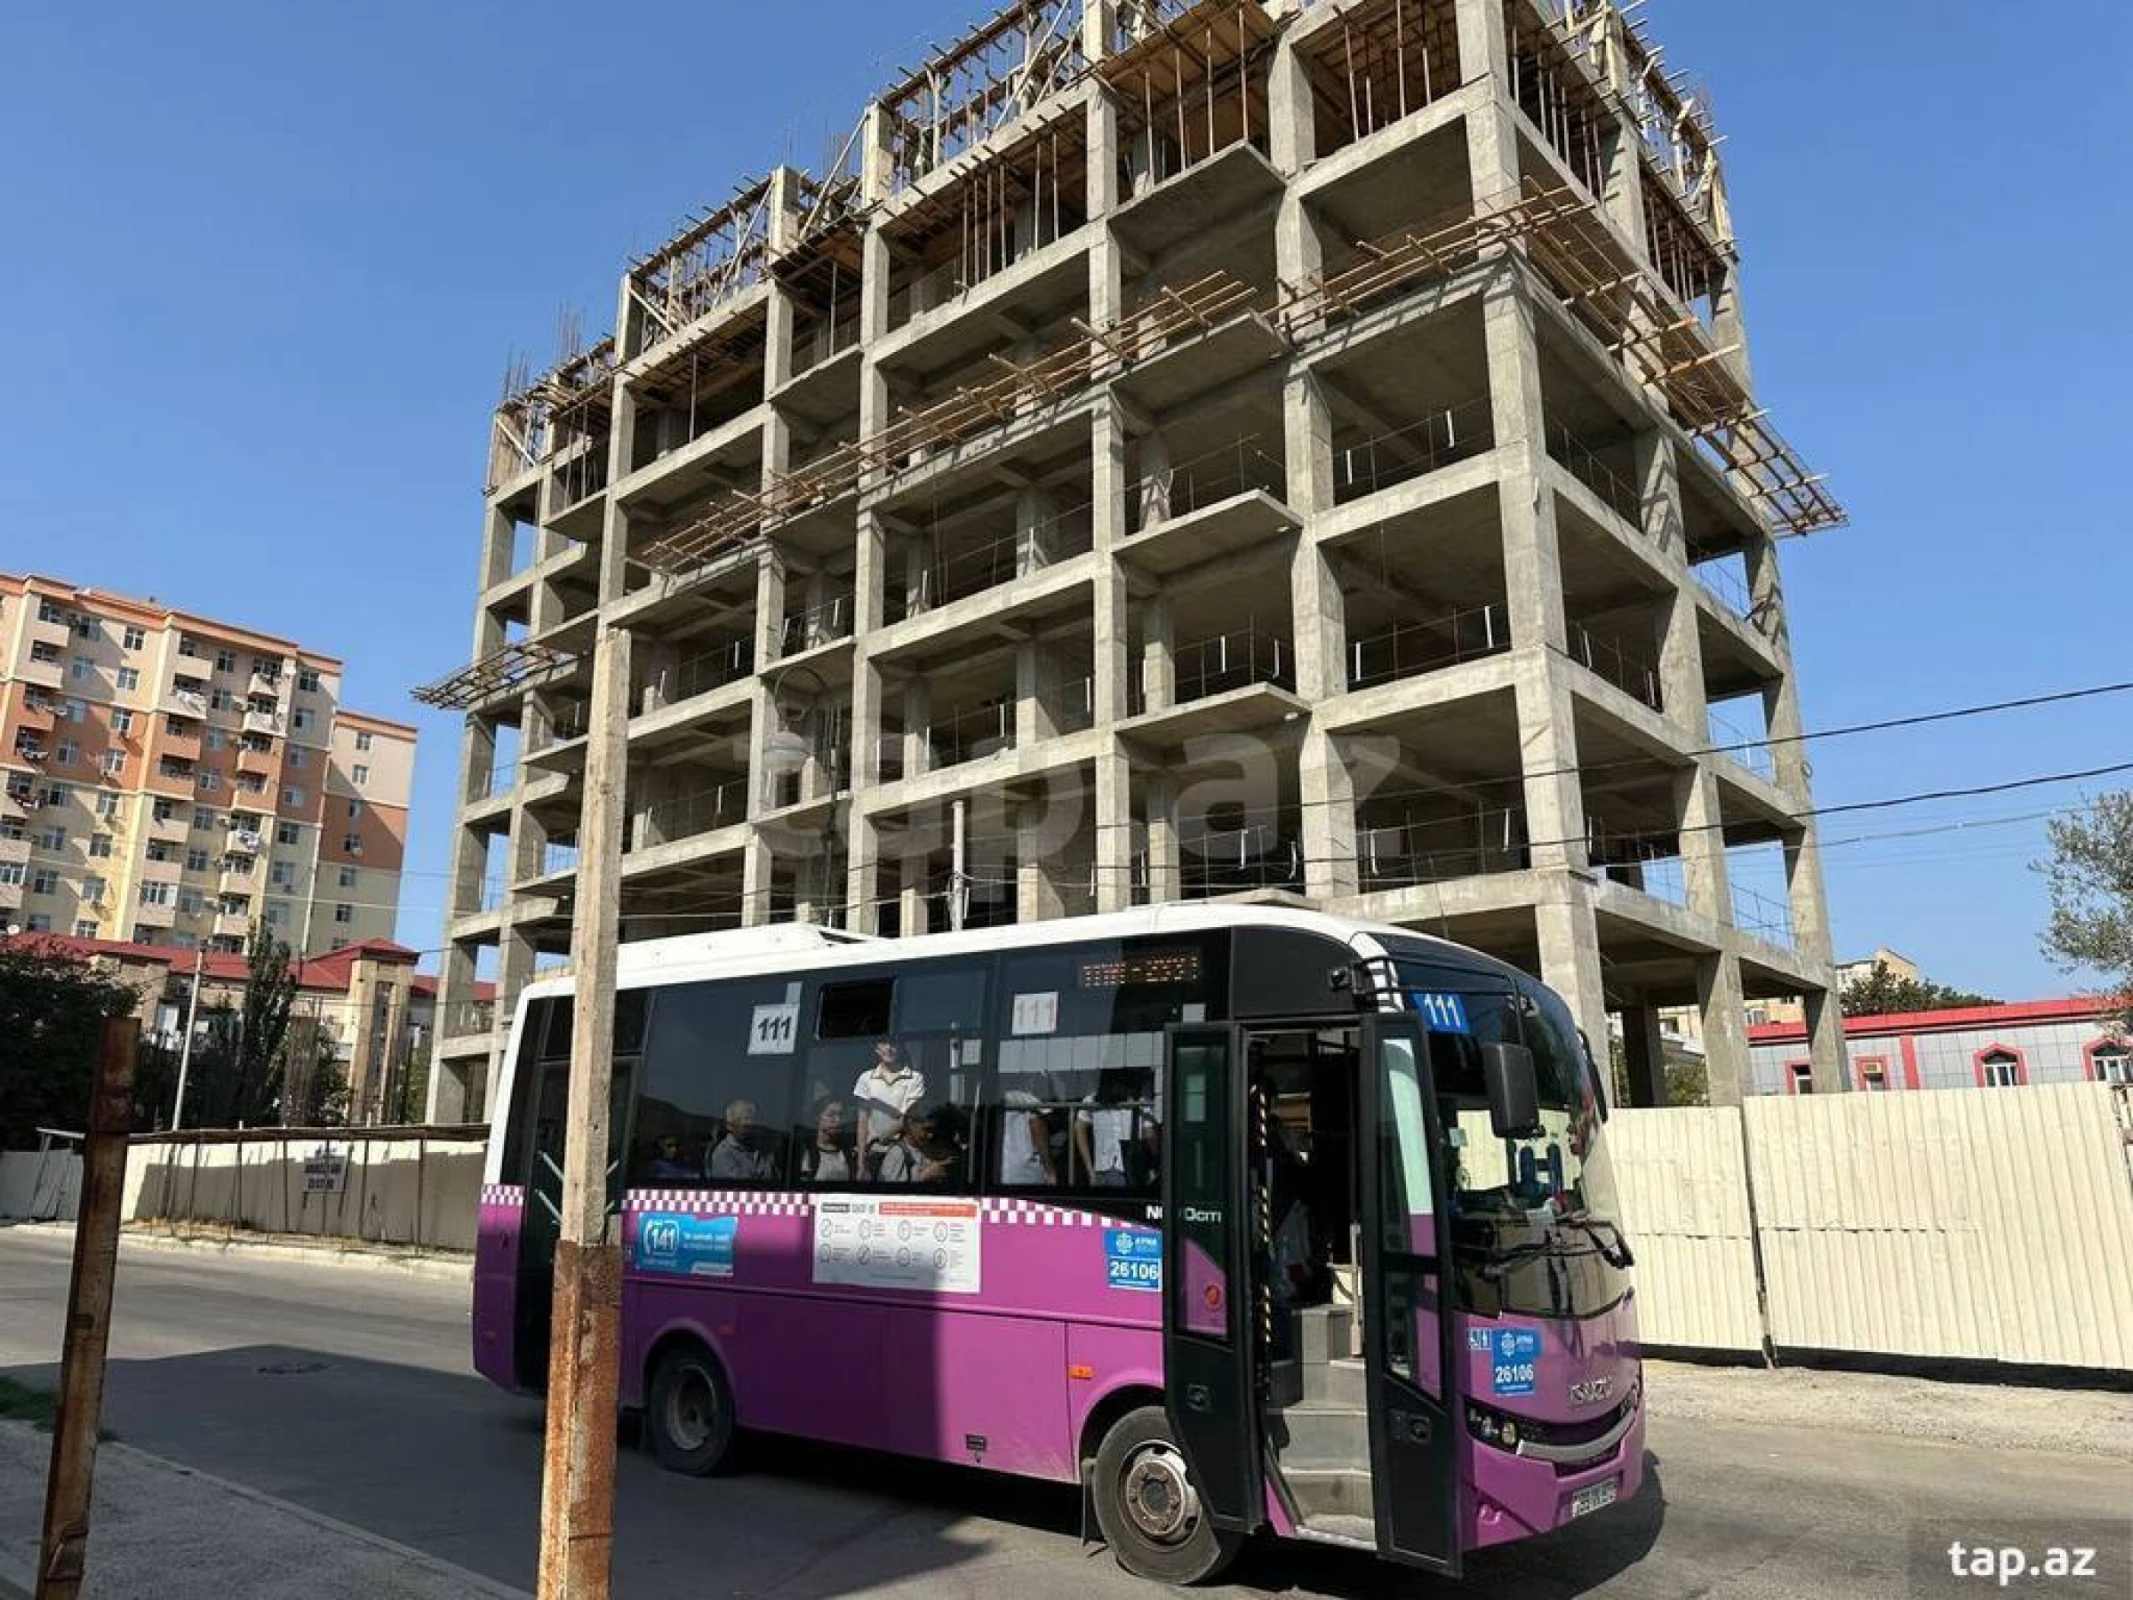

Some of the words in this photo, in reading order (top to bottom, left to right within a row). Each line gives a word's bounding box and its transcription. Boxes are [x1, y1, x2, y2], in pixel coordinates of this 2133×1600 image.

[1424, 992, 1462, 1028] 111
[757, 1016, 793, 1042] 111
[1109, 1260, 1159, 1280] 26106
[1495, 1363, 1534, 1384] 26106
